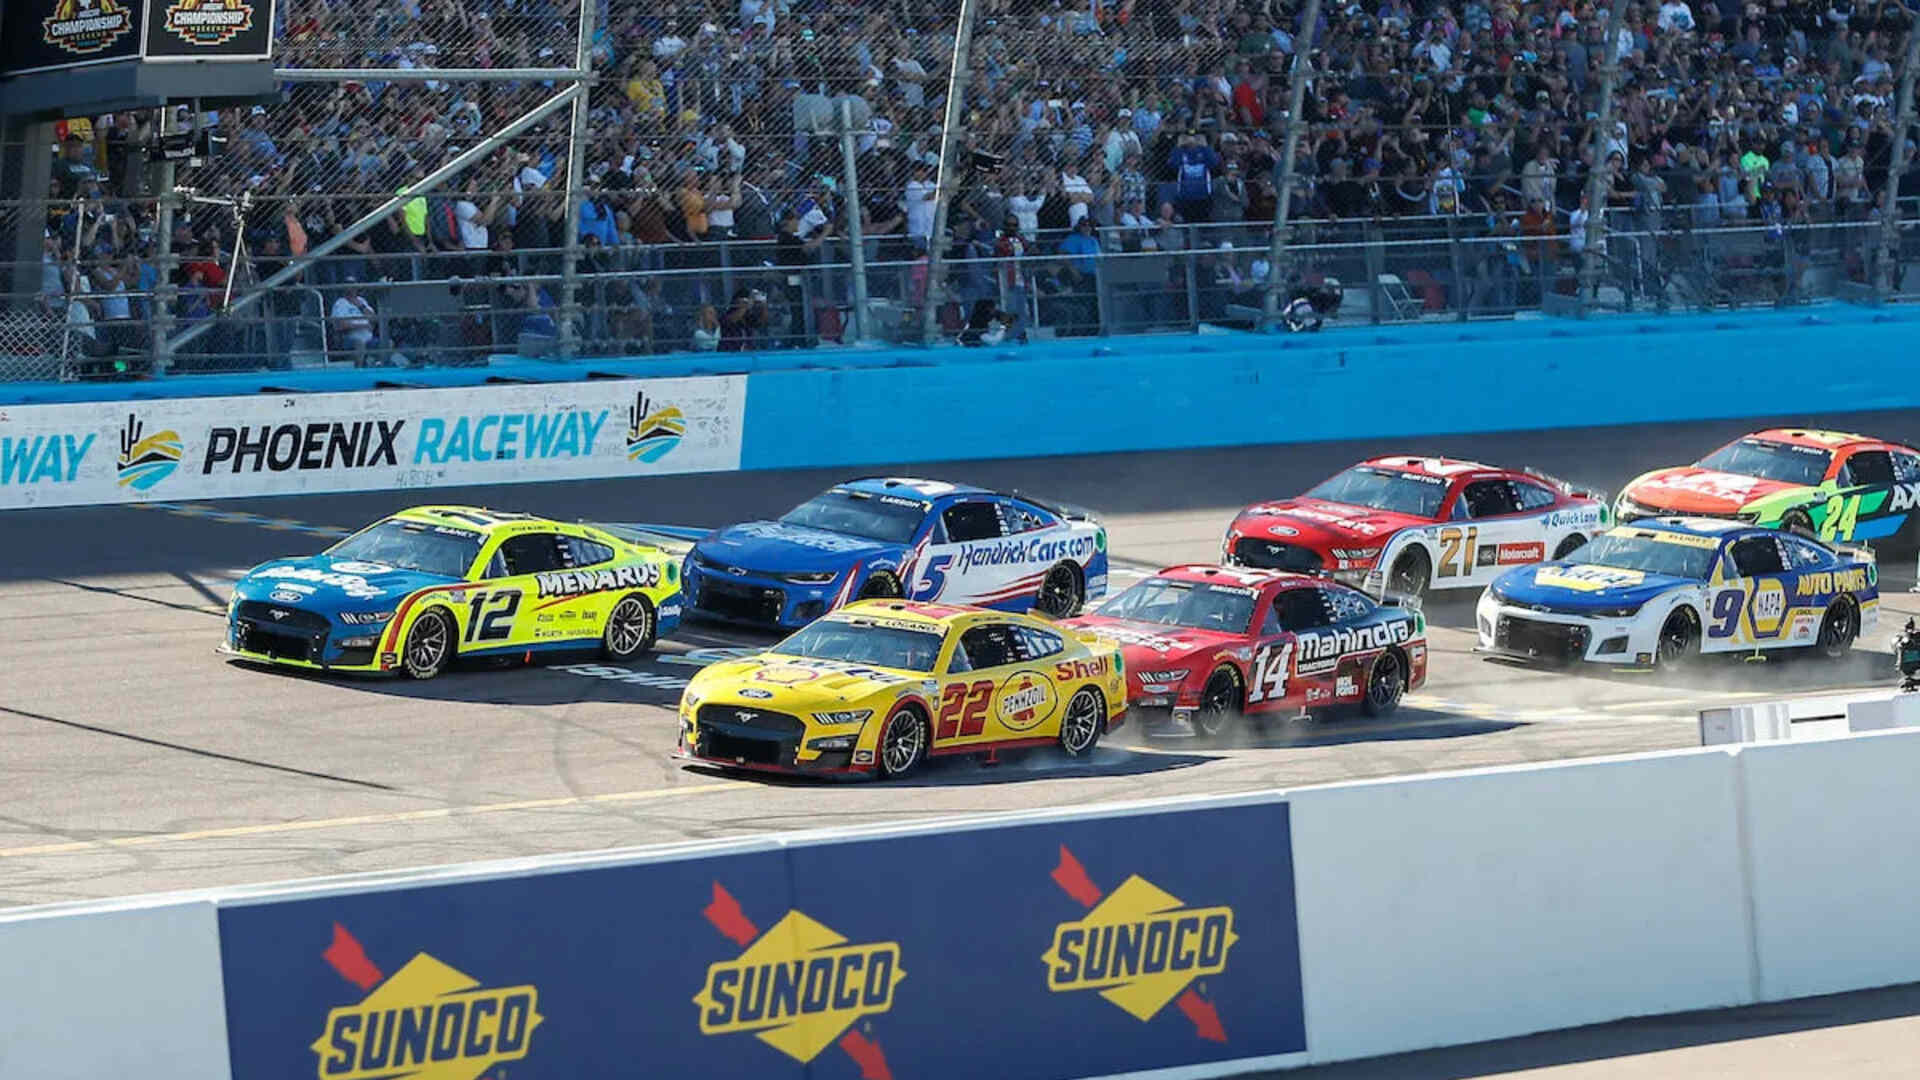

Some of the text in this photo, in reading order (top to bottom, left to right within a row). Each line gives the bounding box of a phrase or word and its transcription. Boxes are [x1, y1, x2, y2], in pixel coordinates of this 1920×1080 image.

[52, 14, 123, 36] CHAMPIONSHIP
[174, 11, 245, 25] CHAMPIONSHIP
[0, 432, 97, 485] WAY
[202, 410, 609, 475] PHOENIX RACEWAY
[1401, 473, 1441, 485] BURTON
[880, 495, 922, 508] LARSON
[1551, 512, 1598, 527] Quick Lane
[1820, 494, 1862, 542] 24
[434, 526, 476, 539] BLANEY
[1437, 526, 1478, 578] 21
[958, 536, 1094, 575] HendrickCars.com
[1499, 547, 1540, 560] Motorcraft
[536, 562, 661, 599] MENARDS
[914, 553, 953, 602] 5
[1796, 568, 1867, 596] AUTO PARTS
[464, 589, 523, 642] 12
[1708, 589, 1746, 638] 9
[1758, 591, 1781, 616] NAPA
[885, 620, 937, 631] LOGANO
[1298, 620, 1409, 660] Mahindra
[1055, 656, 1108, 681] Shell
[1249, 643, 1293, 703] 14
[936, 680, 995, 740] 22
[1002, 686, 1047, 714] PENNZOIL
[1053, 914, 1227, 986] SUNOCO
[705, 950, 894, 1026] SUNOCO
[324, 993, 531, 1076] SUNOCO
